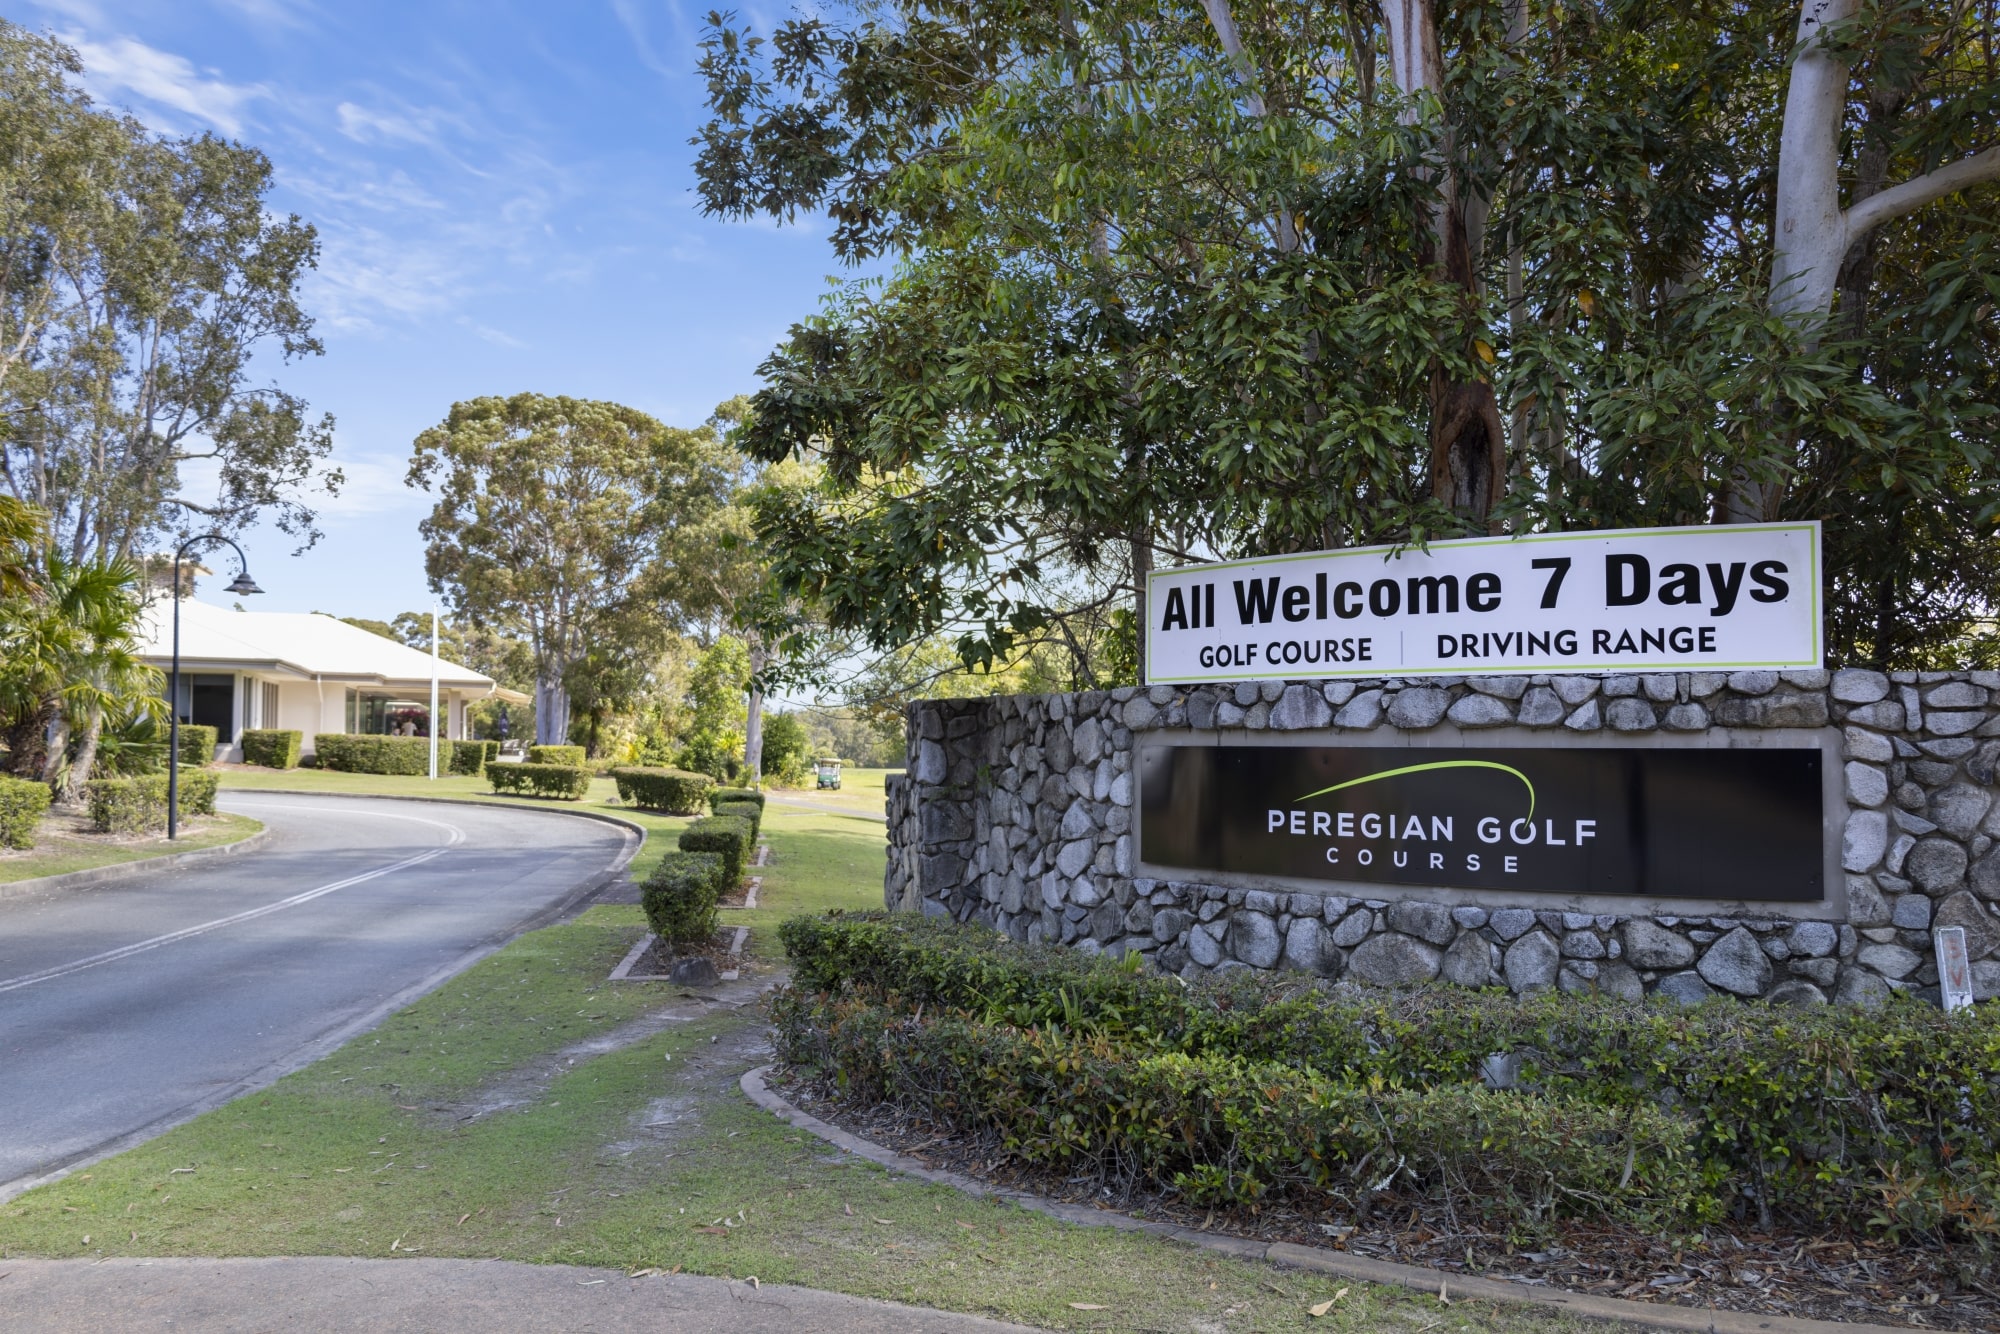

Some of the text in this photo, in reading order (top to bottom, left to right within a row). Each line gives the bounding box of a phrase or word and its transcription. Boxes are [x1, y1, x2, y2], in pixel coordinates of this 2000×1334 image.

[1161, 553, 1790, 632] All Welcome 7 Days
[1199, 637, 1372, 669] GOLF COURSE
[1437, 626, 1717, 659] DRIVING RANGE
[1267, 808, 1597, 847] PEREGIAN GOLF
[1326, 847, 1519, 874] COURSE
